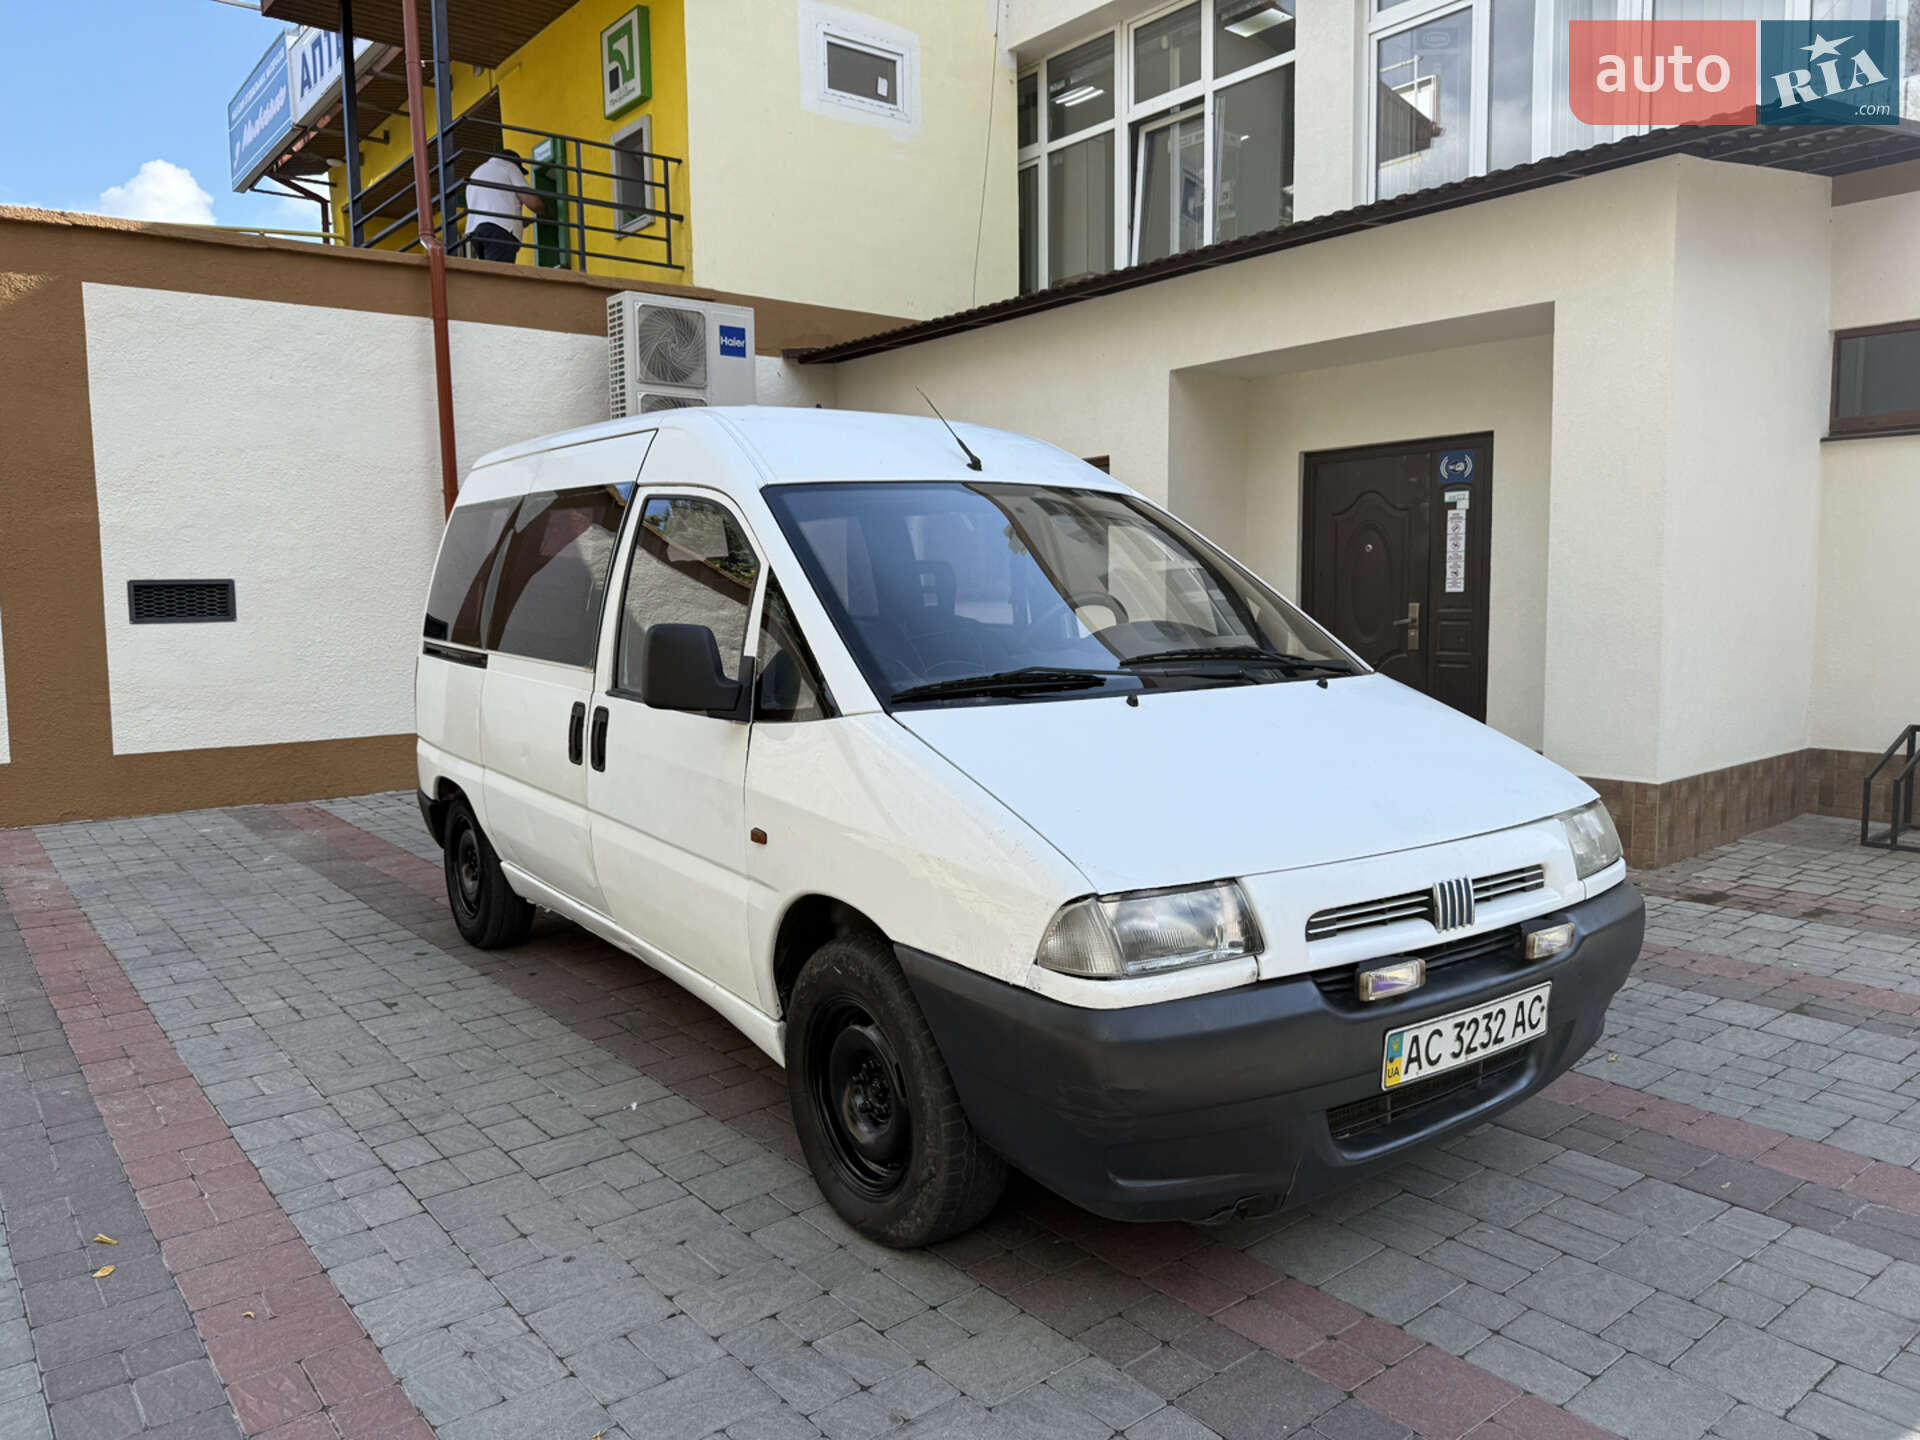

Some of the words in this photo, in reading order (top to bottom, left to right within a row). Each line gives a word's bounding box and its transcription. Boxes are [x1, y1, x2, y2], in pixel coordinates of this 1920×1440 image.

[720, 335, 745, 347] Haier
[1404, 1029, 1443, 1074] AC
[1451, 1008, 1506, 1058] 3232
[1512, 995, 1542, 1039] AC
[1387, 1064, 1400, 1079] UA
